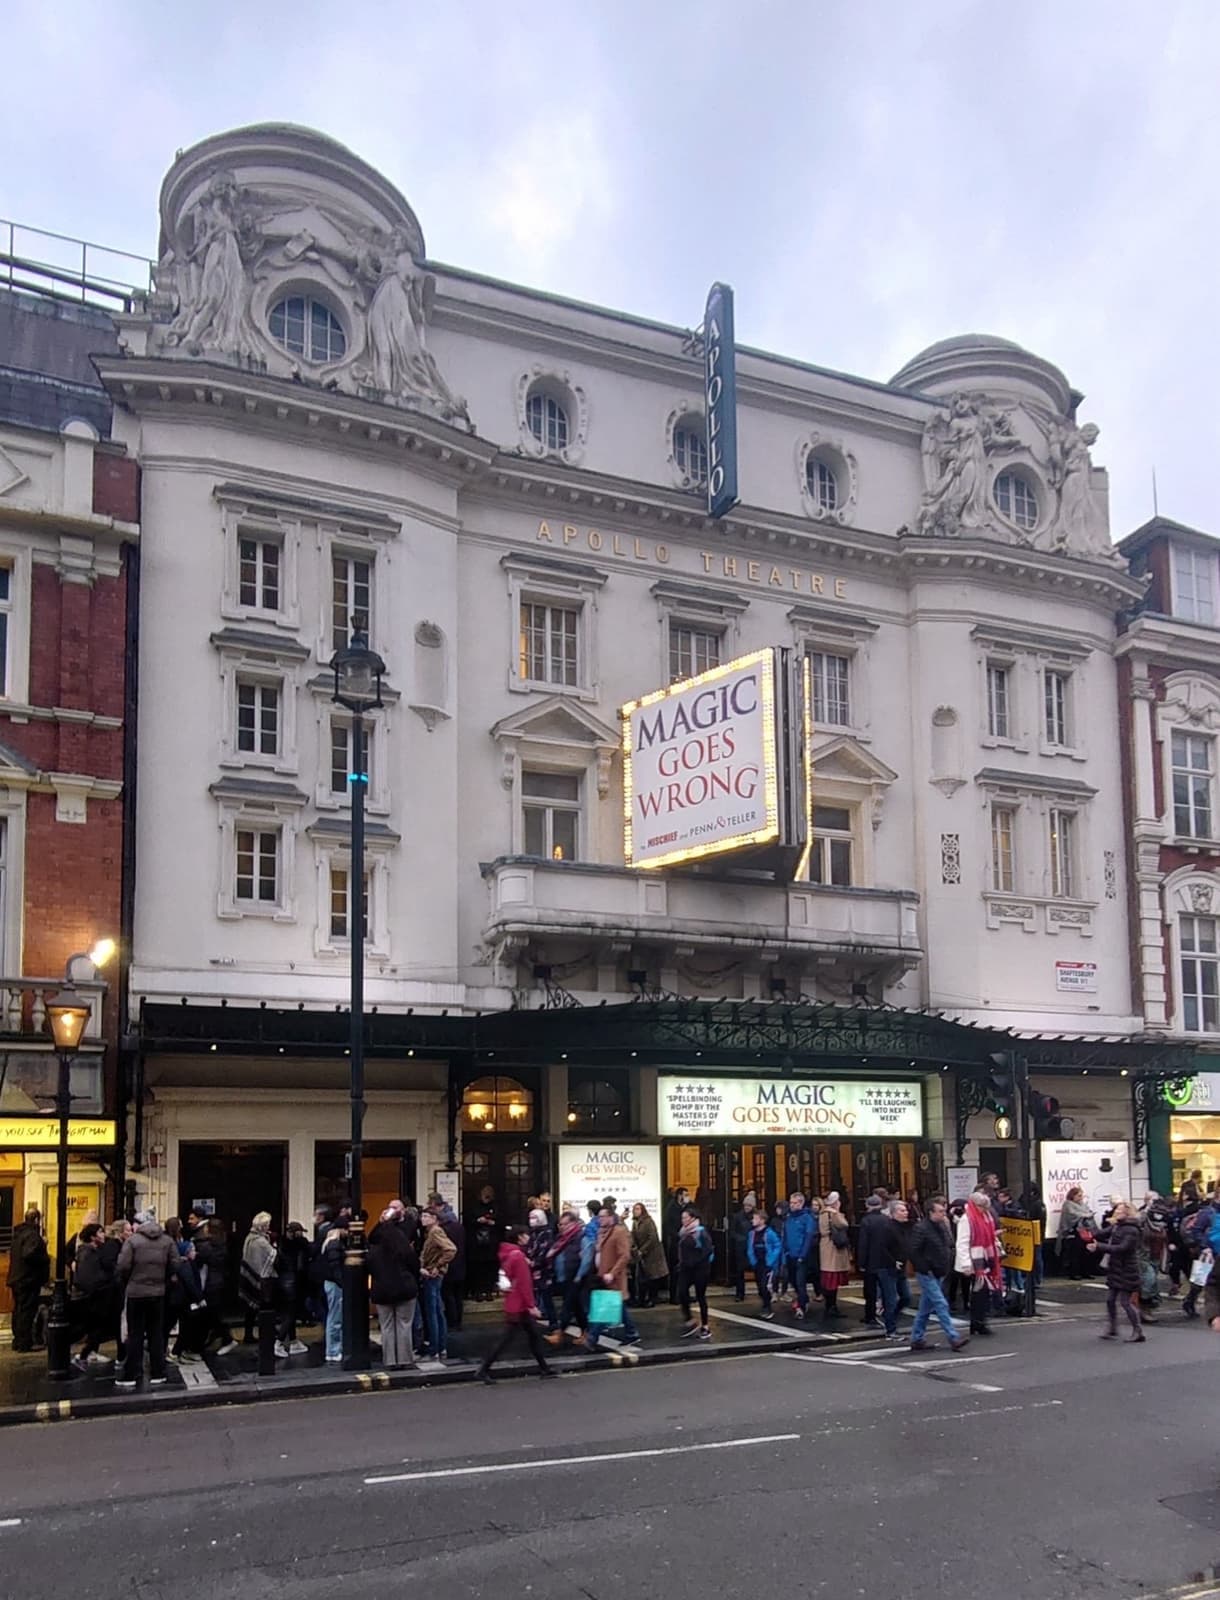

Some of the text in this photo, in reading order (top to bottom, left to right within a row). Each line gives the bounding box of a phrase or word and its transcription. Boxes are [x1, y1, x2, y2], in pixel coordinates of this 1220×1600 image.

[707, 318, 723, 497] APOLLO
[537, 519, 848, 599] APOLLO THEATRE
[636, 675, 757, 752] MAGIC
[658, 727, 735, 777] GOES
[638, 766, 758, 820] WRONG
[647, 831, 678, 848] MISCHIEF
[689, 822, 714, 838] PENN
[727, 810, 757, 827] TELLER
[757, 1084, 836, 1106] MAGIC
[884, 1099, 917, 1107] LAUGHING
[670, 1103, 720, 1111] ROMP BY THE
[672, 1111, 719, 1119] MASTERS OF
[732, 1107, 857, 1129] GOES WRONG
[586, 1151, 634, 1163] MAGIC
[571, 1164, 647, 1176] GOES WRONG
[1047, 1168, 1089, 1181] MAGIC
[1005, 1242, 1024, 1257] Ends
